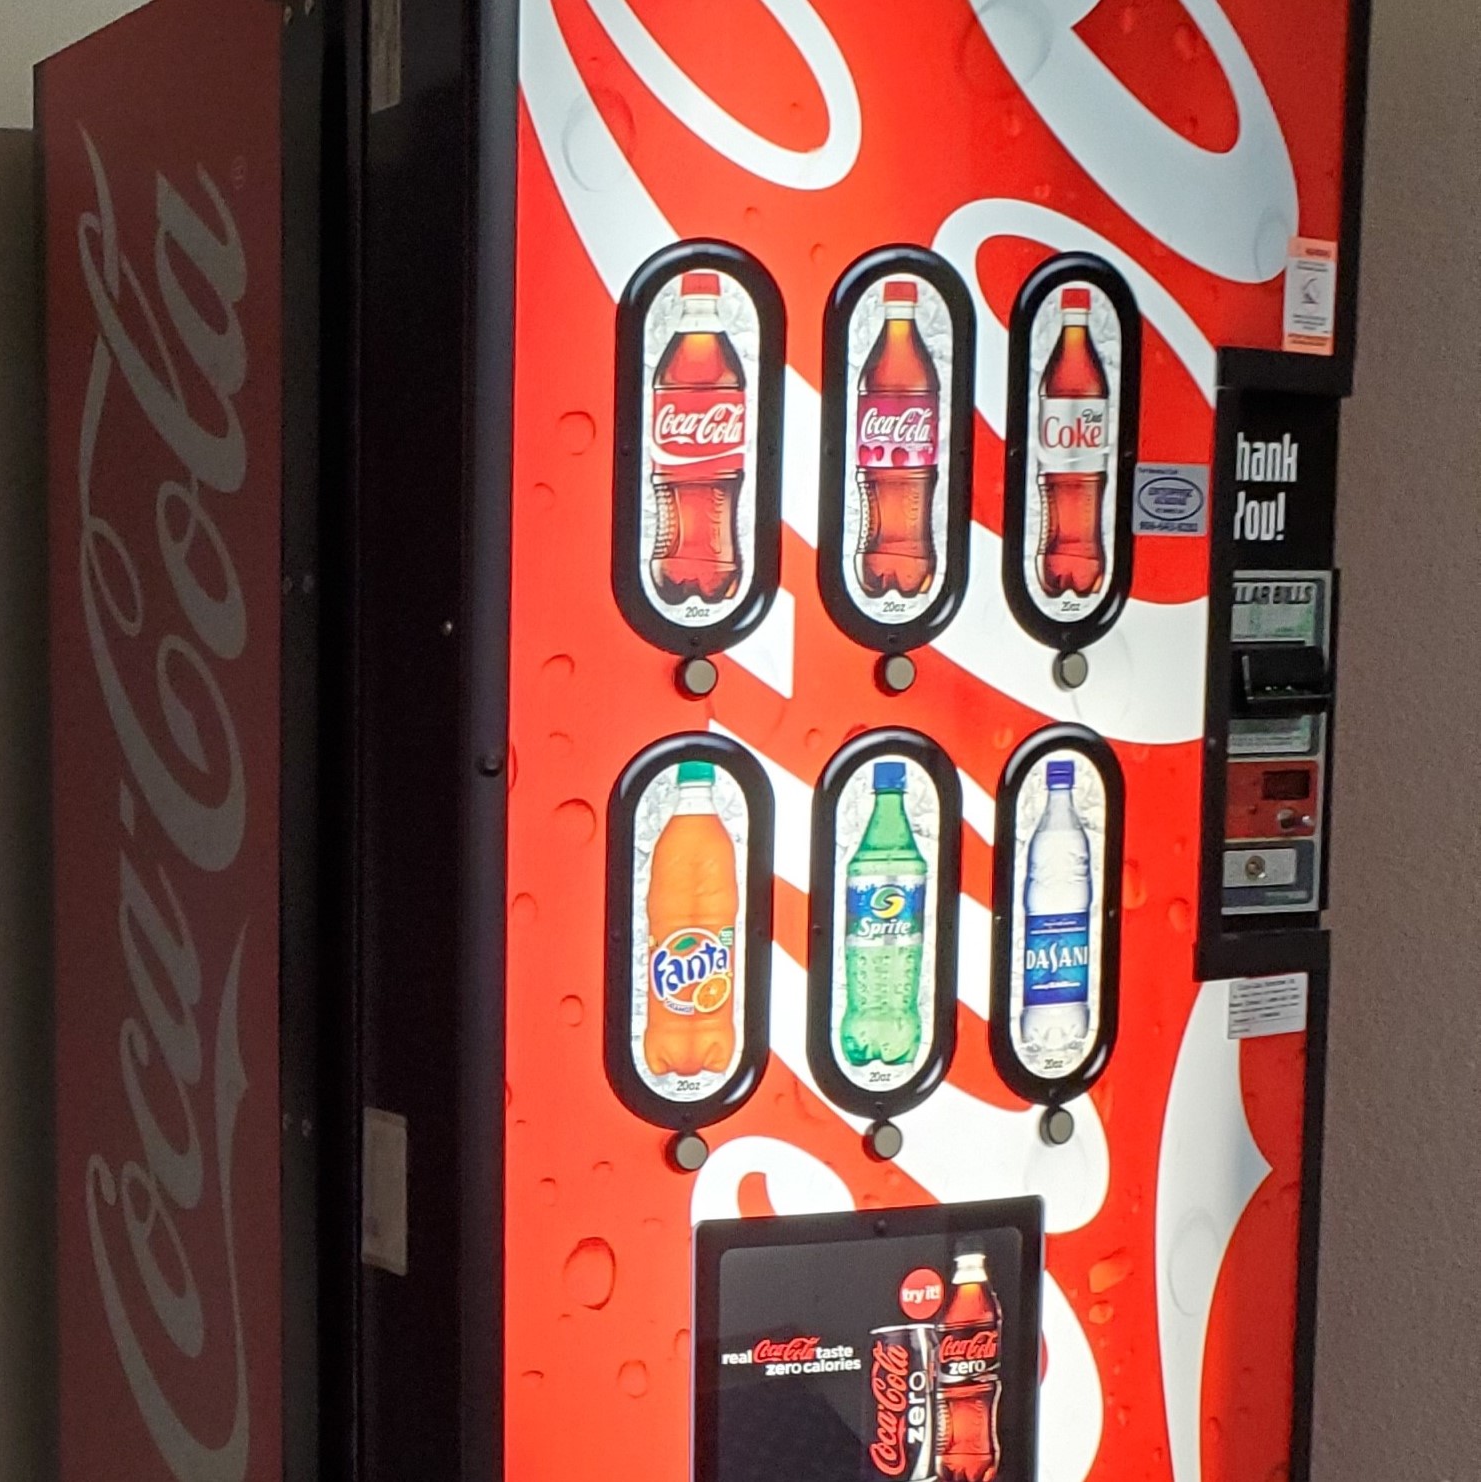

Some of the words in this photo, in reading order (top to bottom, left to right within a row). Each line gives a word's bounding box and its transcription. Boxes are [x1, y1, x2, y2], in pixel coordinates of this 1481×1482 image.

[655, 402, 745, 445] Coca-Cola
[861, 407, 933, 442] Coca-Cola
[1081, 408, 1103, 424] Diet
[1043, 416, 1102, 449] Coke
[1235, 431, 1299, 482] hank
[684, 607, 710, 618] 20oz
[882, 601, 906, 612] 20oz
[1061, 601, 1081, 612] 20oz
[857, 917, 911, 941] Sprite
[653, 942, 728, 998] Fanta
[1025, 942, 1089, 974] DASANI
[1044, 1058, 1064, 1069] 20oz
[676, 1080, 701, 1091] 20oz
[868, 1071, 892, 1083] 20oz
[901, 1288, 924, 1303] try
[925, 1285, 941, 1300] it!
[721, 1349, 753, 1364] real
[754, 1336, 821, 1363] Coca-Cola
[815, 1345, 854, 1359] taste
[938, 1330, 999, 1362] Coca-Cola
[765, 1362, 802, 1376] zero
[803, 1358, 862, 1374] calories
[948, 1359, 987, 1375] zero
[870, 1340, 910, 1476] Coca-Cola
[907, 1369, 926, 1444] zero
